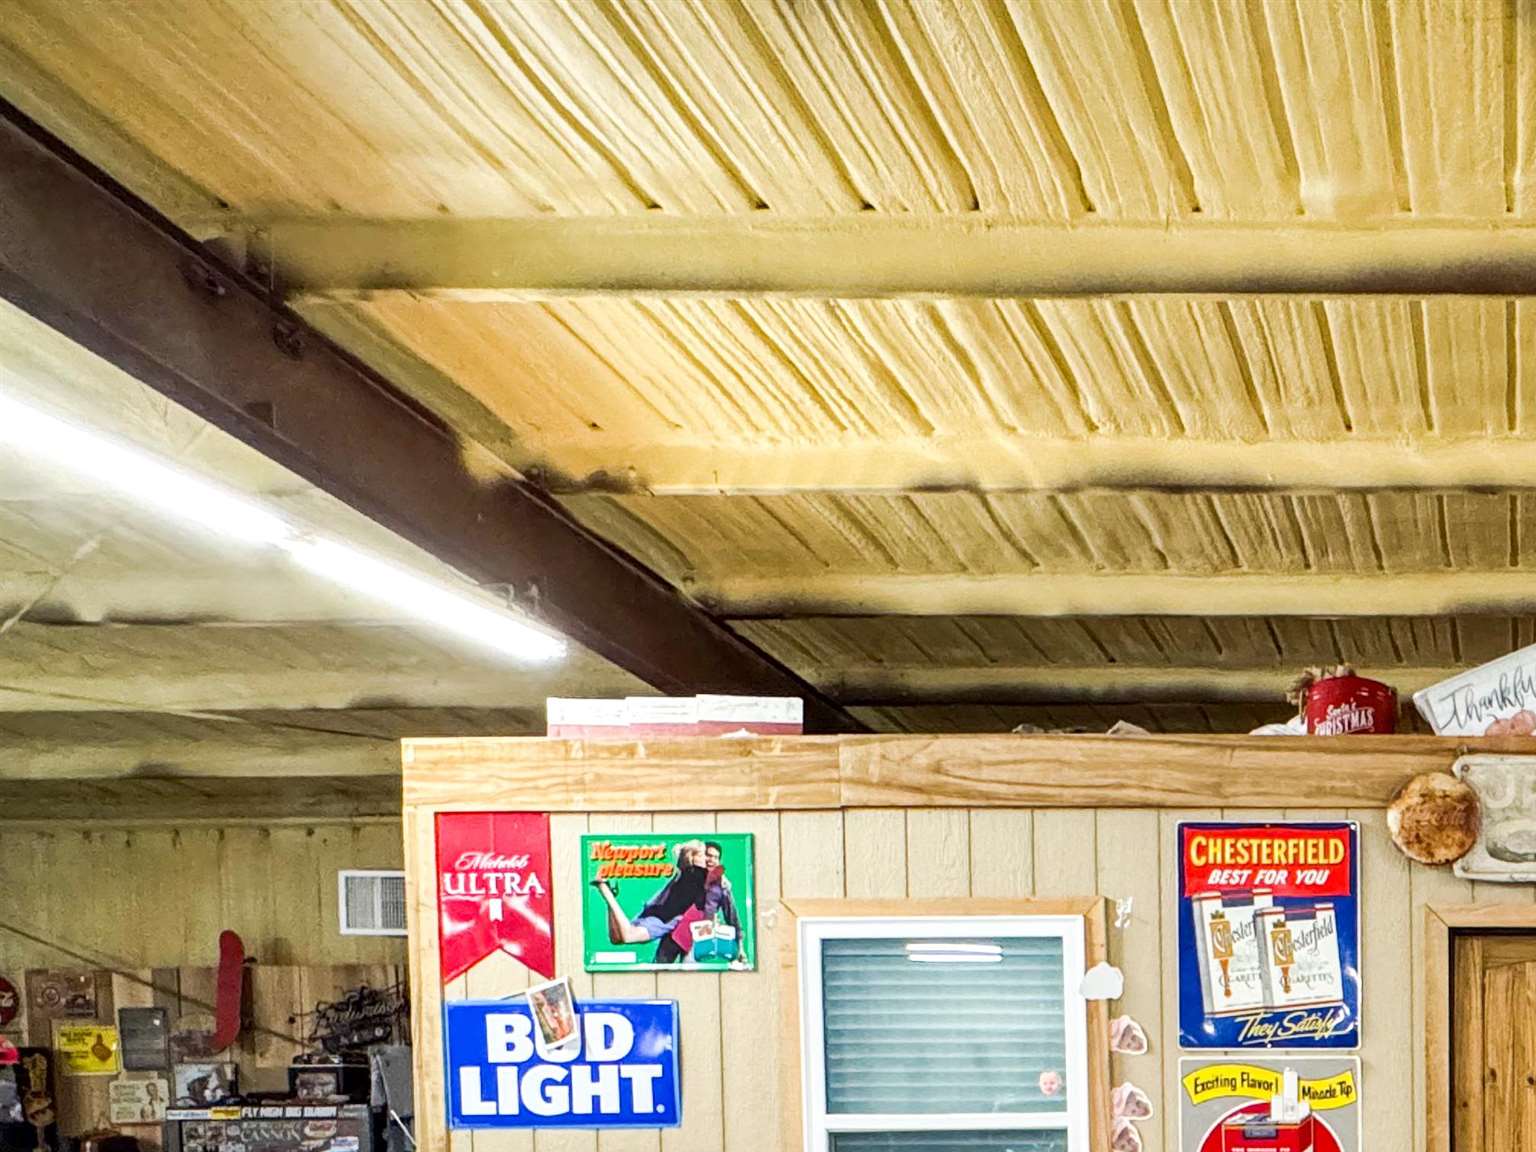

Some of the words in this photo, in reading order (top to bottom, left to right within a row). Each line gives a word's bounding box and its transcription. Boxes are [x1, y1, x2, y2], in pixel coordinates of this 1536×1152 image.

[453, 851, 532, 872] Michelob
[590, 841, 667, 864] Newport
[1189, 836, 1346, 867] CHESTERFIELD
[597, 860, 676, 880] pleasure
[1208, 868, 1253, 886] BEST
[1253, 868, 1289, 886] FOR
[1294, 868, 1331, 886] YOU
[441, 871, 546, 896] ULTRA
[1234, 1012, 1280, 1043] They
[1193, 1074, 1238, 1095] Exciting
[1301, 1085, 1338, 1100] Miracle
[1339, 1081, 1354, 1098] Tip
